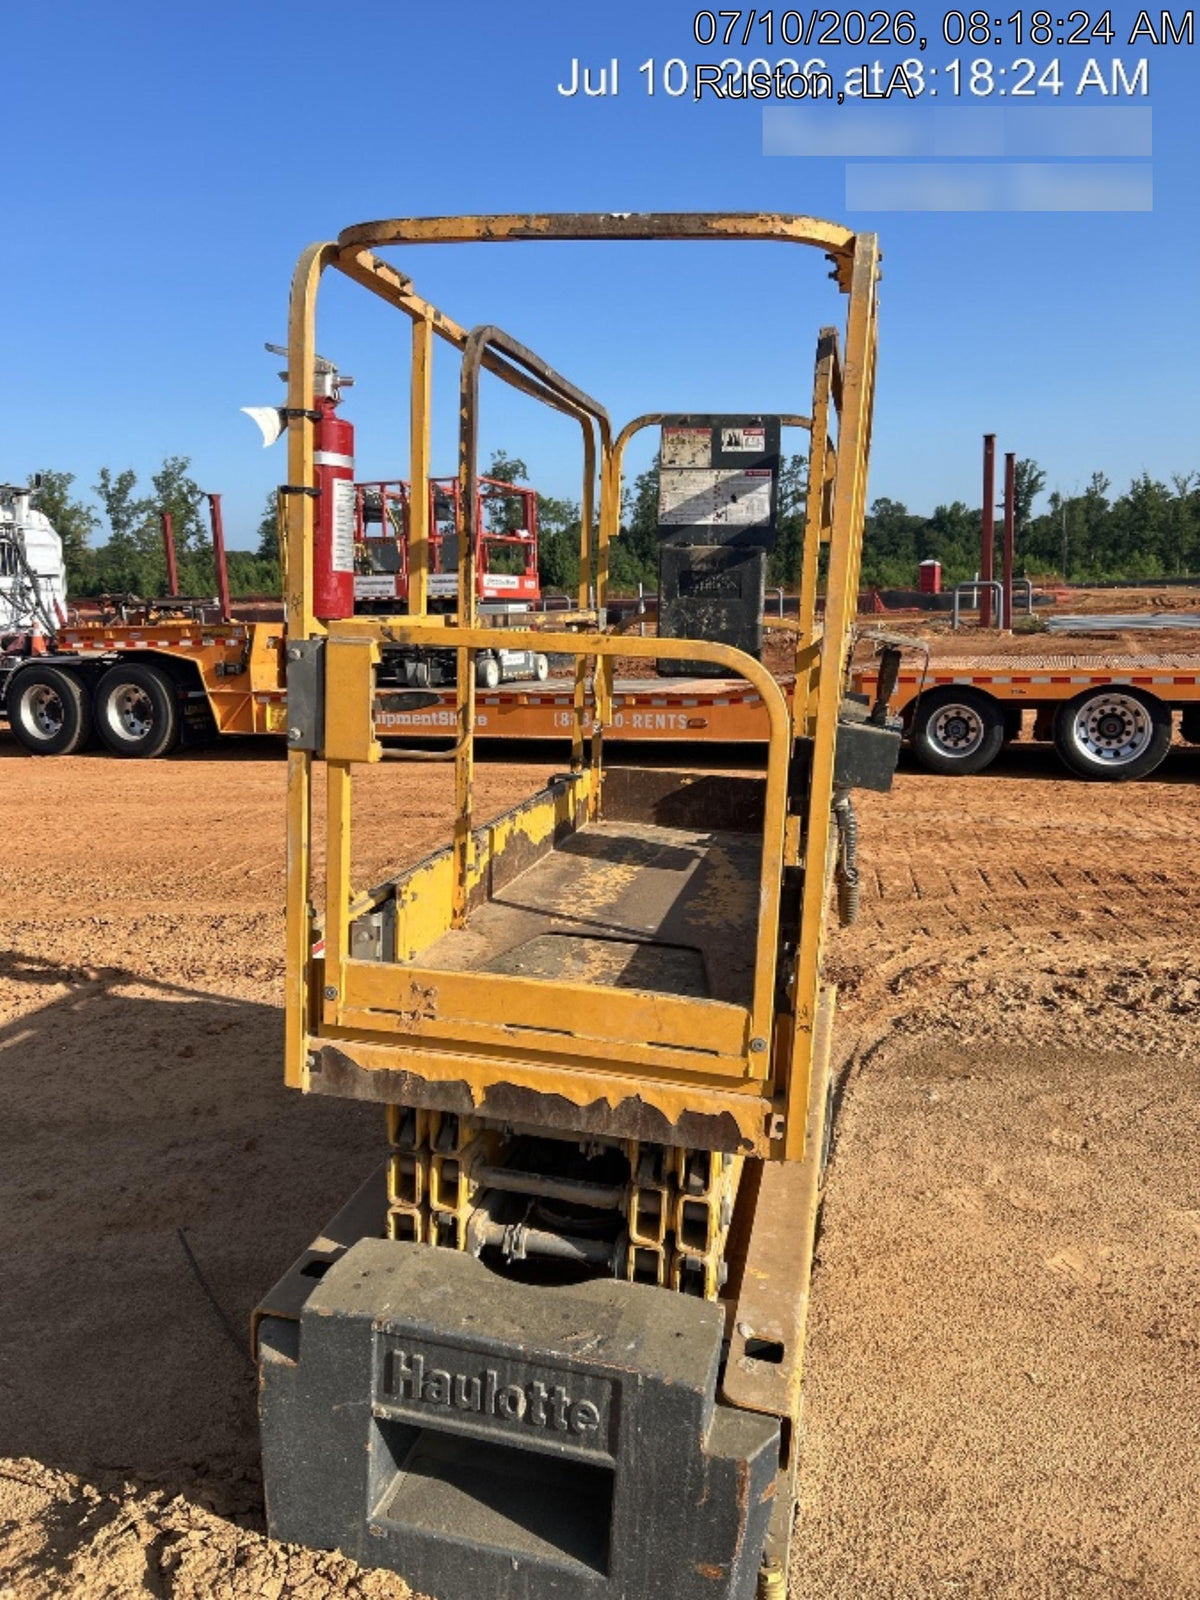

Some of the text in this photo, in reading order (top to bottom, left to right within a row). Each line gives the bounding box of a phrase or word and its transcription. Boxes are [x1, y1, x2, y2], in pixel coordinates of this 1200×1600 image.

[374, 710, 488, 728] uipmentShe
[603, 713, 688, 730] 0-RENTS
[388, 1348, 600, 1435] Haulotte
